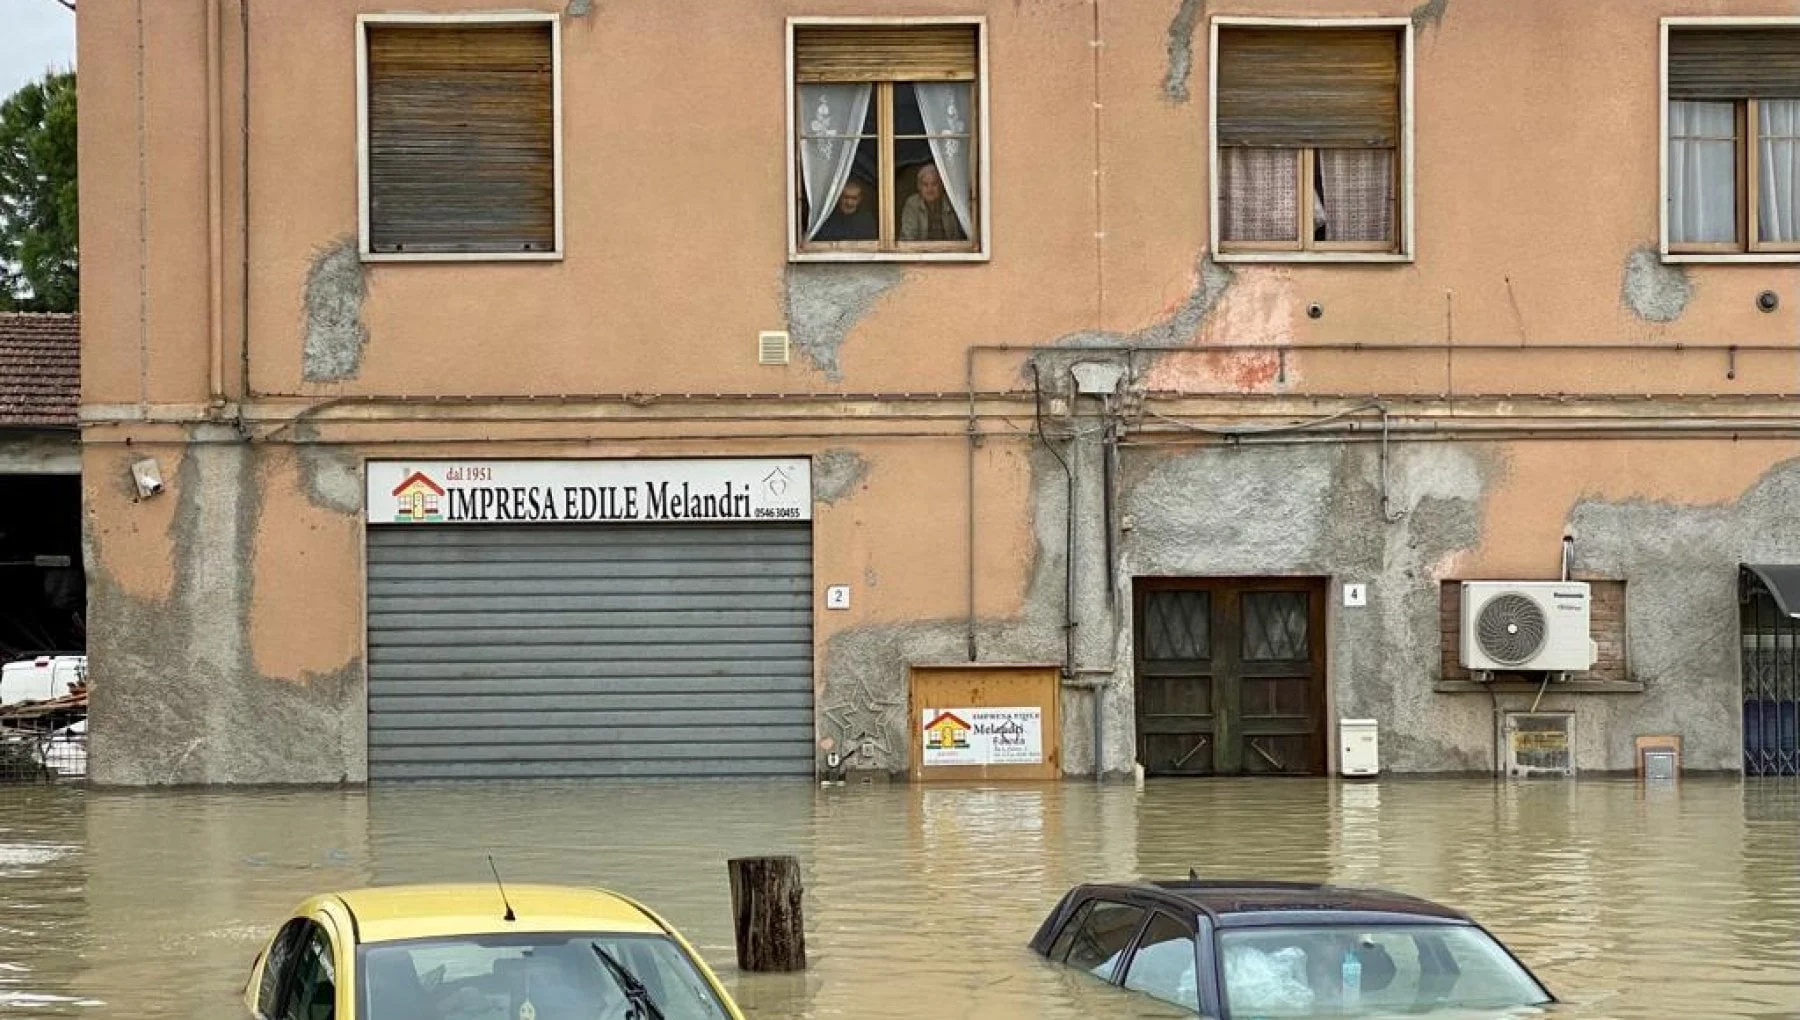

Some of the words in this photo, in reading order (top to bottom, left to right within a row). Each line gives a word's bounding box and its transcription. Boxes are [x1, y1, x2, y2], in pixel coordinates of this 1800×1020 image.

[446, 467, 463, 481] dal
[466, 467, 493, 481] 1951
[447, 486, 559, 520] IMPRESA
[564, 486, 639, 520] EDILE
[645, 481, 751, 519] Melandri
[834, 588, 843, 602] 2
[1350, 587, 1358, 600] 4
